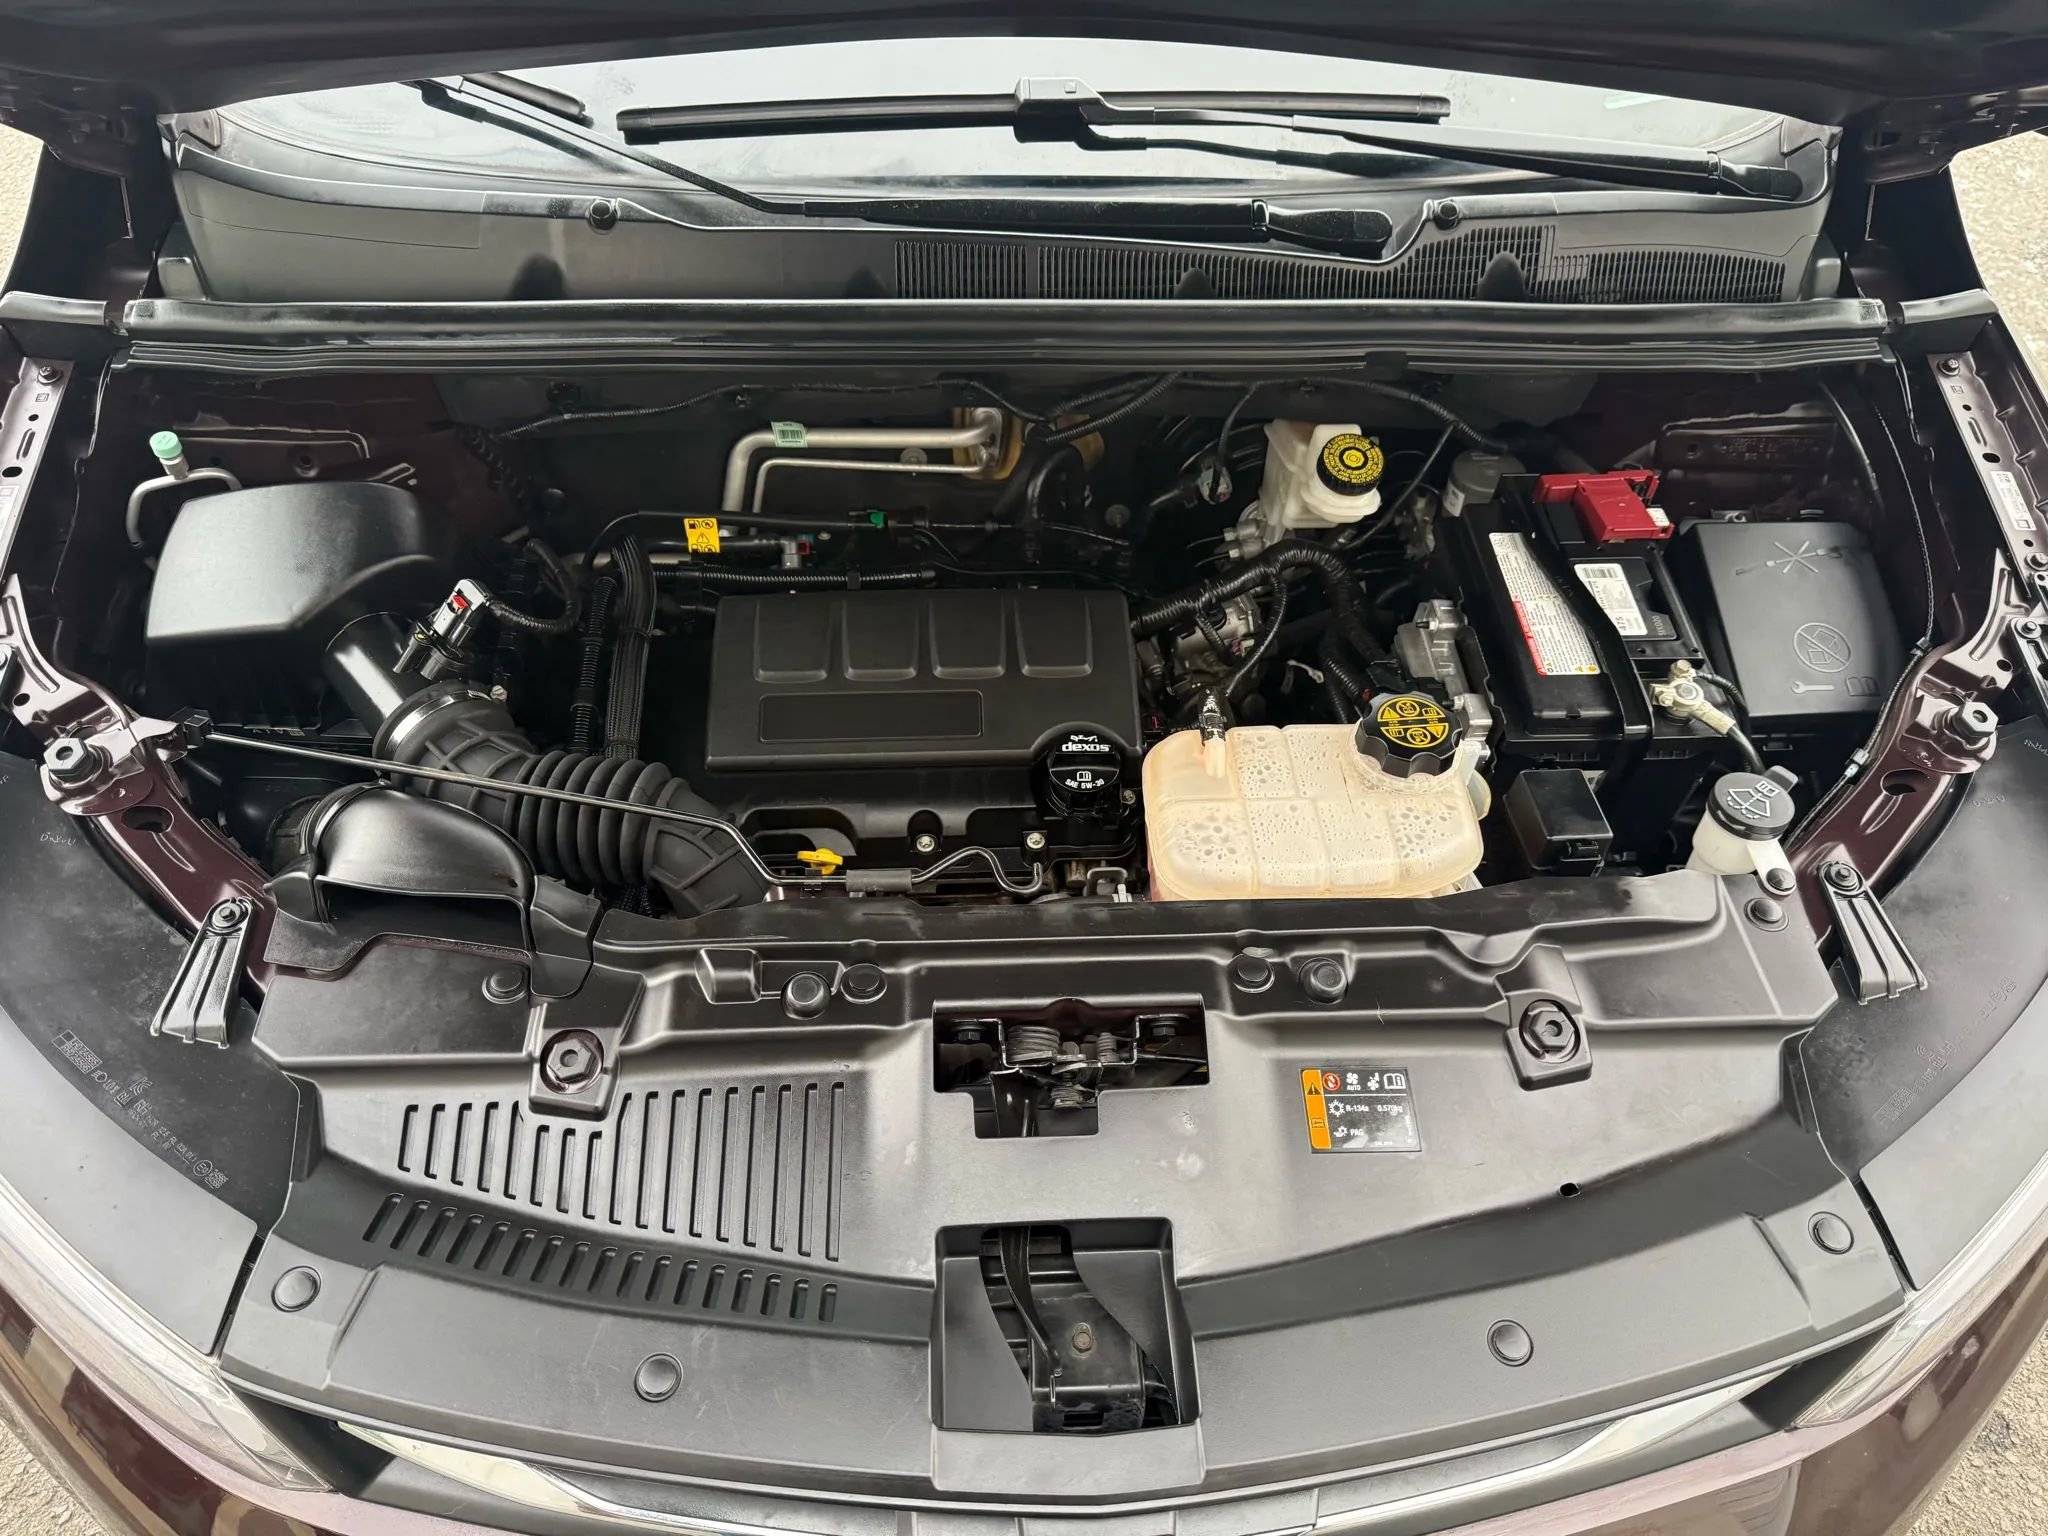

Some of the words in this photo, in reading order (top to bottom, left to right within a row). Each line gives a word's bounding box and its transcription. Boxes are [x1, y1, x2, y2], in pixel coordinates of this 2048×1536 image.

[1061, 742, 1110, 752] dexos
[1065, 778, 1078, 789] SAE
[1081, 778, 1105, 790] 5W-30
[1345, 1104, 1369, 1113] R-134a
[1350, 1128, 1365, 1136] PAG
